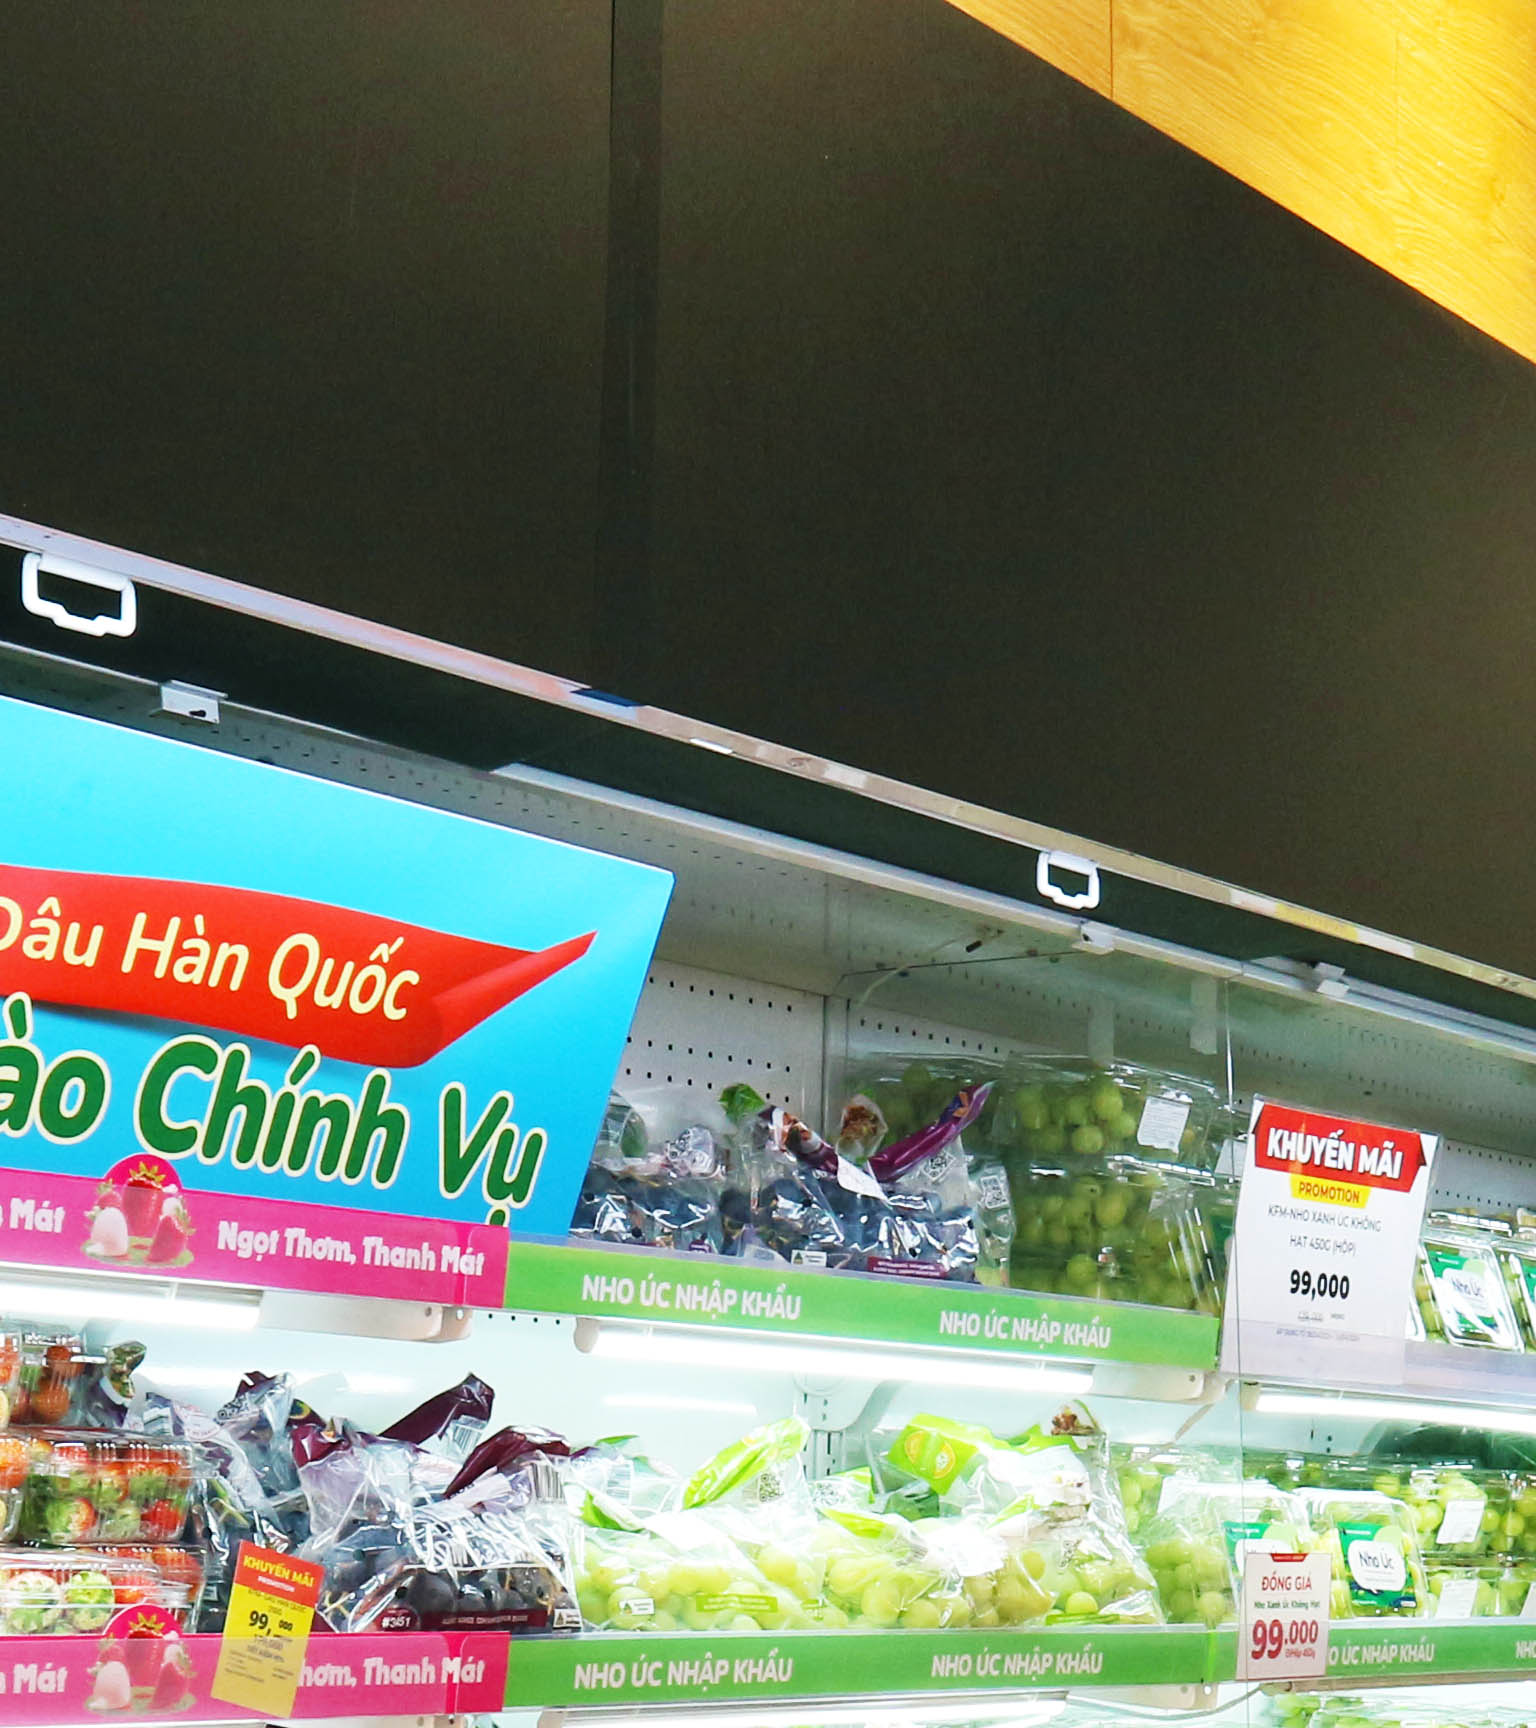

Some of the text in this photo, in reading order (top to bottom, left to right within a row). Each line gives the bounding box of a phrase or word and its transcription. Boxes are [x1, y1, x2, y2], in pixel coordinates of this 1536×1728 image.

[120, 911, 250, 992] Hàn
[267, 933, 422, 1022] Quốc
[136, 1033, 411, 1189] Chính
[437, 1080, 548, 1230] Vụ
[1267, 1128, 1404, 1180] KHUYẾN MÃI
[1298, 1181, 1360, 1204] PROMOTION
[9, 1197, 66, 1236] Mát
[1268, 1204, 1310, 1222] KFM-NHO
[1312, 1210, 1335, 1226] XANH
[1351, 1214, 1382, 1232] KHÔNG
[581, 1268, 802, 1323] NHO ÚC NHẬP KHẨU
[1290, 1269, 1350, 1300] 99,000
[939, 1306, 1112, 1351] NHO ÚC NHẬP KHẨU
[243, 1555, 315, 1588] KHUYẾN MÃI
[1359, 1548, 1394, 1570] Nho Úc
[1251, 1619, 1319, 1660] 99.000
[13, 1662, 69, 1695] Mát
[297, 1654, 484, 1688] hơm, Thanh Mát
[574, 1649, 793, 1691] NHO ÚC NHẬP KHẨU
[931, 1644, 1103, 1682] NHO ÚC NHẬP KHẨU
